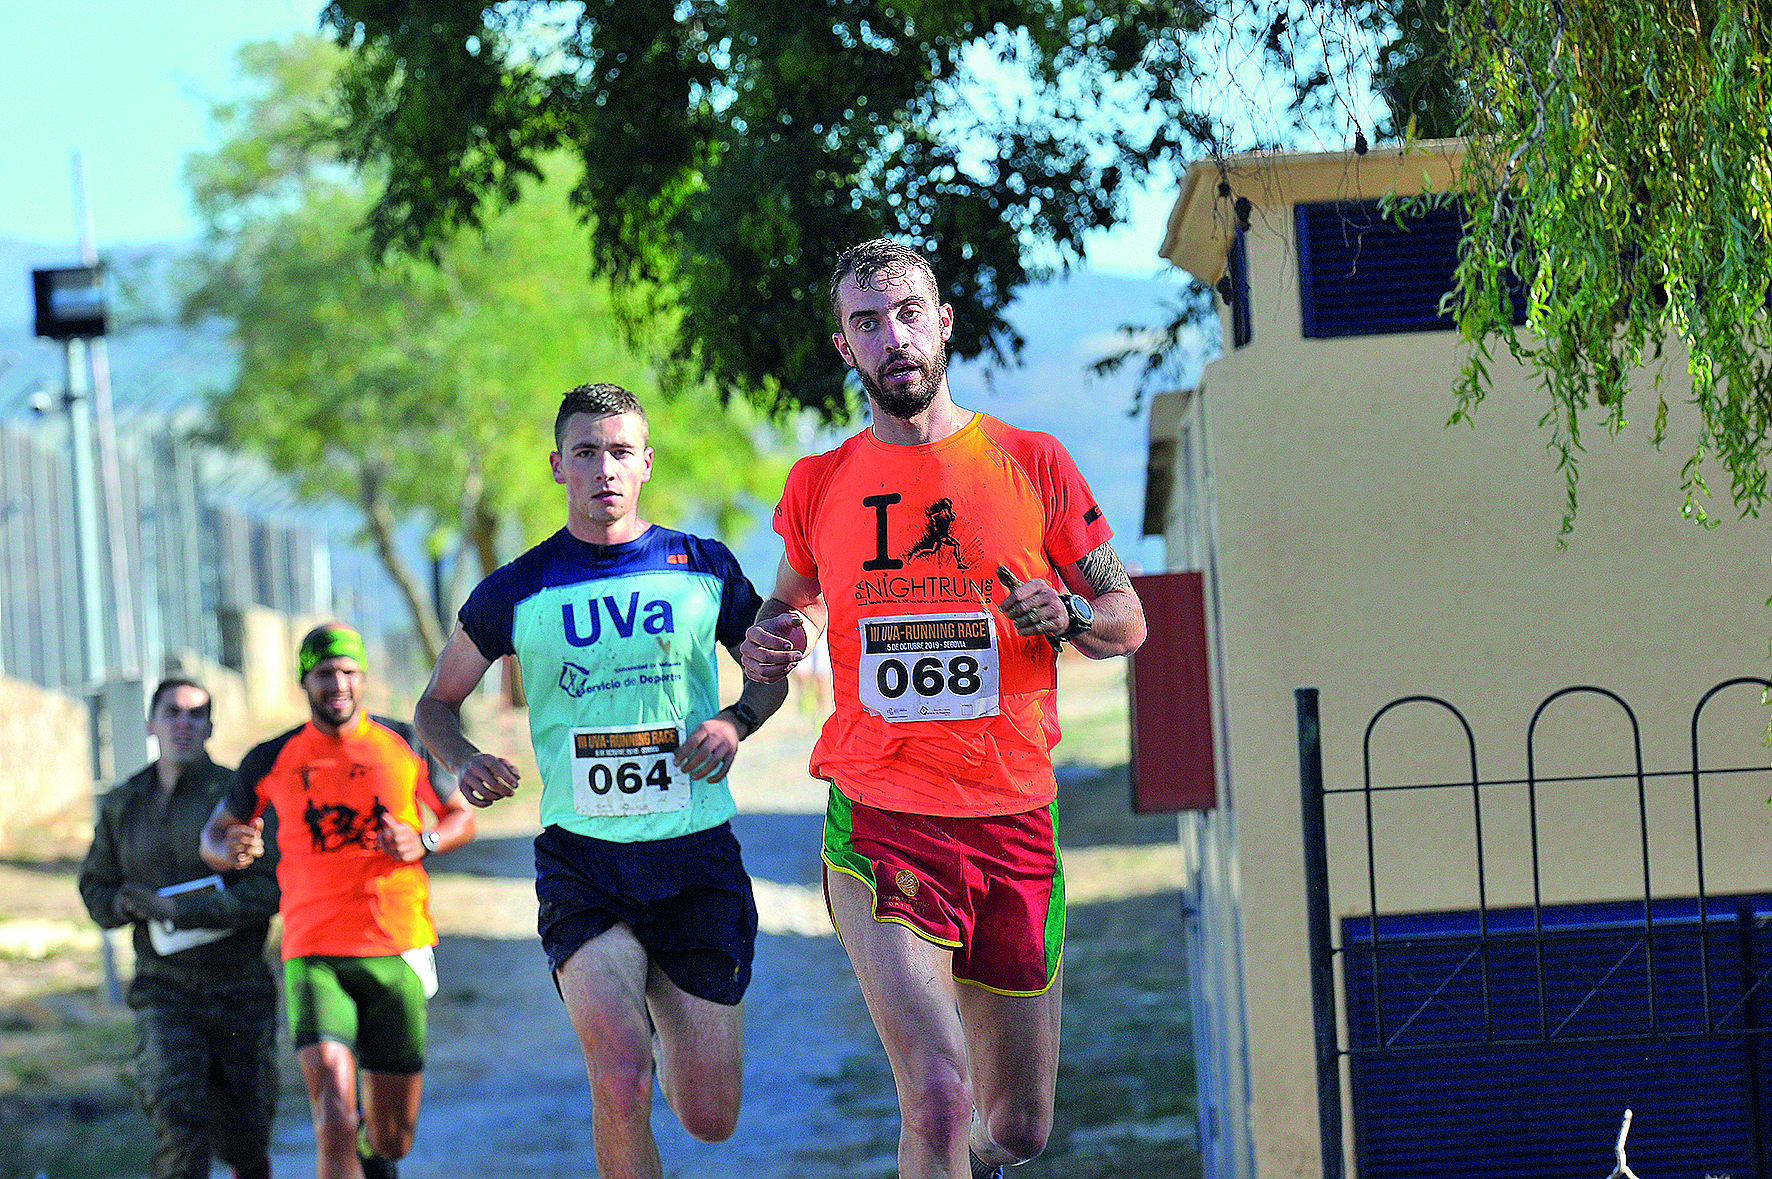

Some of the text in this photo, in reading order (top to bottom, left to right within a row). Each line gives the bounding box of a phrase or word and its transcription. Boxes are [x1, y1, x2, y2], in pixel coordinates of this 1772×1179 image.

[863, 493, 904, 571] I
[855, 579, 868, 607] LPA
[864, 577, 984, 598] NIGHTRUN
[561, 591, 675, 648] UVa
[870, 621, 987, 642] III UVA-RUNNING RACE
[886, 643, 891, 651] 5
[891, 642, 900, 651] DE
[924, 641, 940, 650] 2019
[877, 655, 981, 698] 068
[588, 731, 651, 749] UVA-RUNNING
[652, 729, 675, 745] RACE
[588, 759, 672, 795] 064
